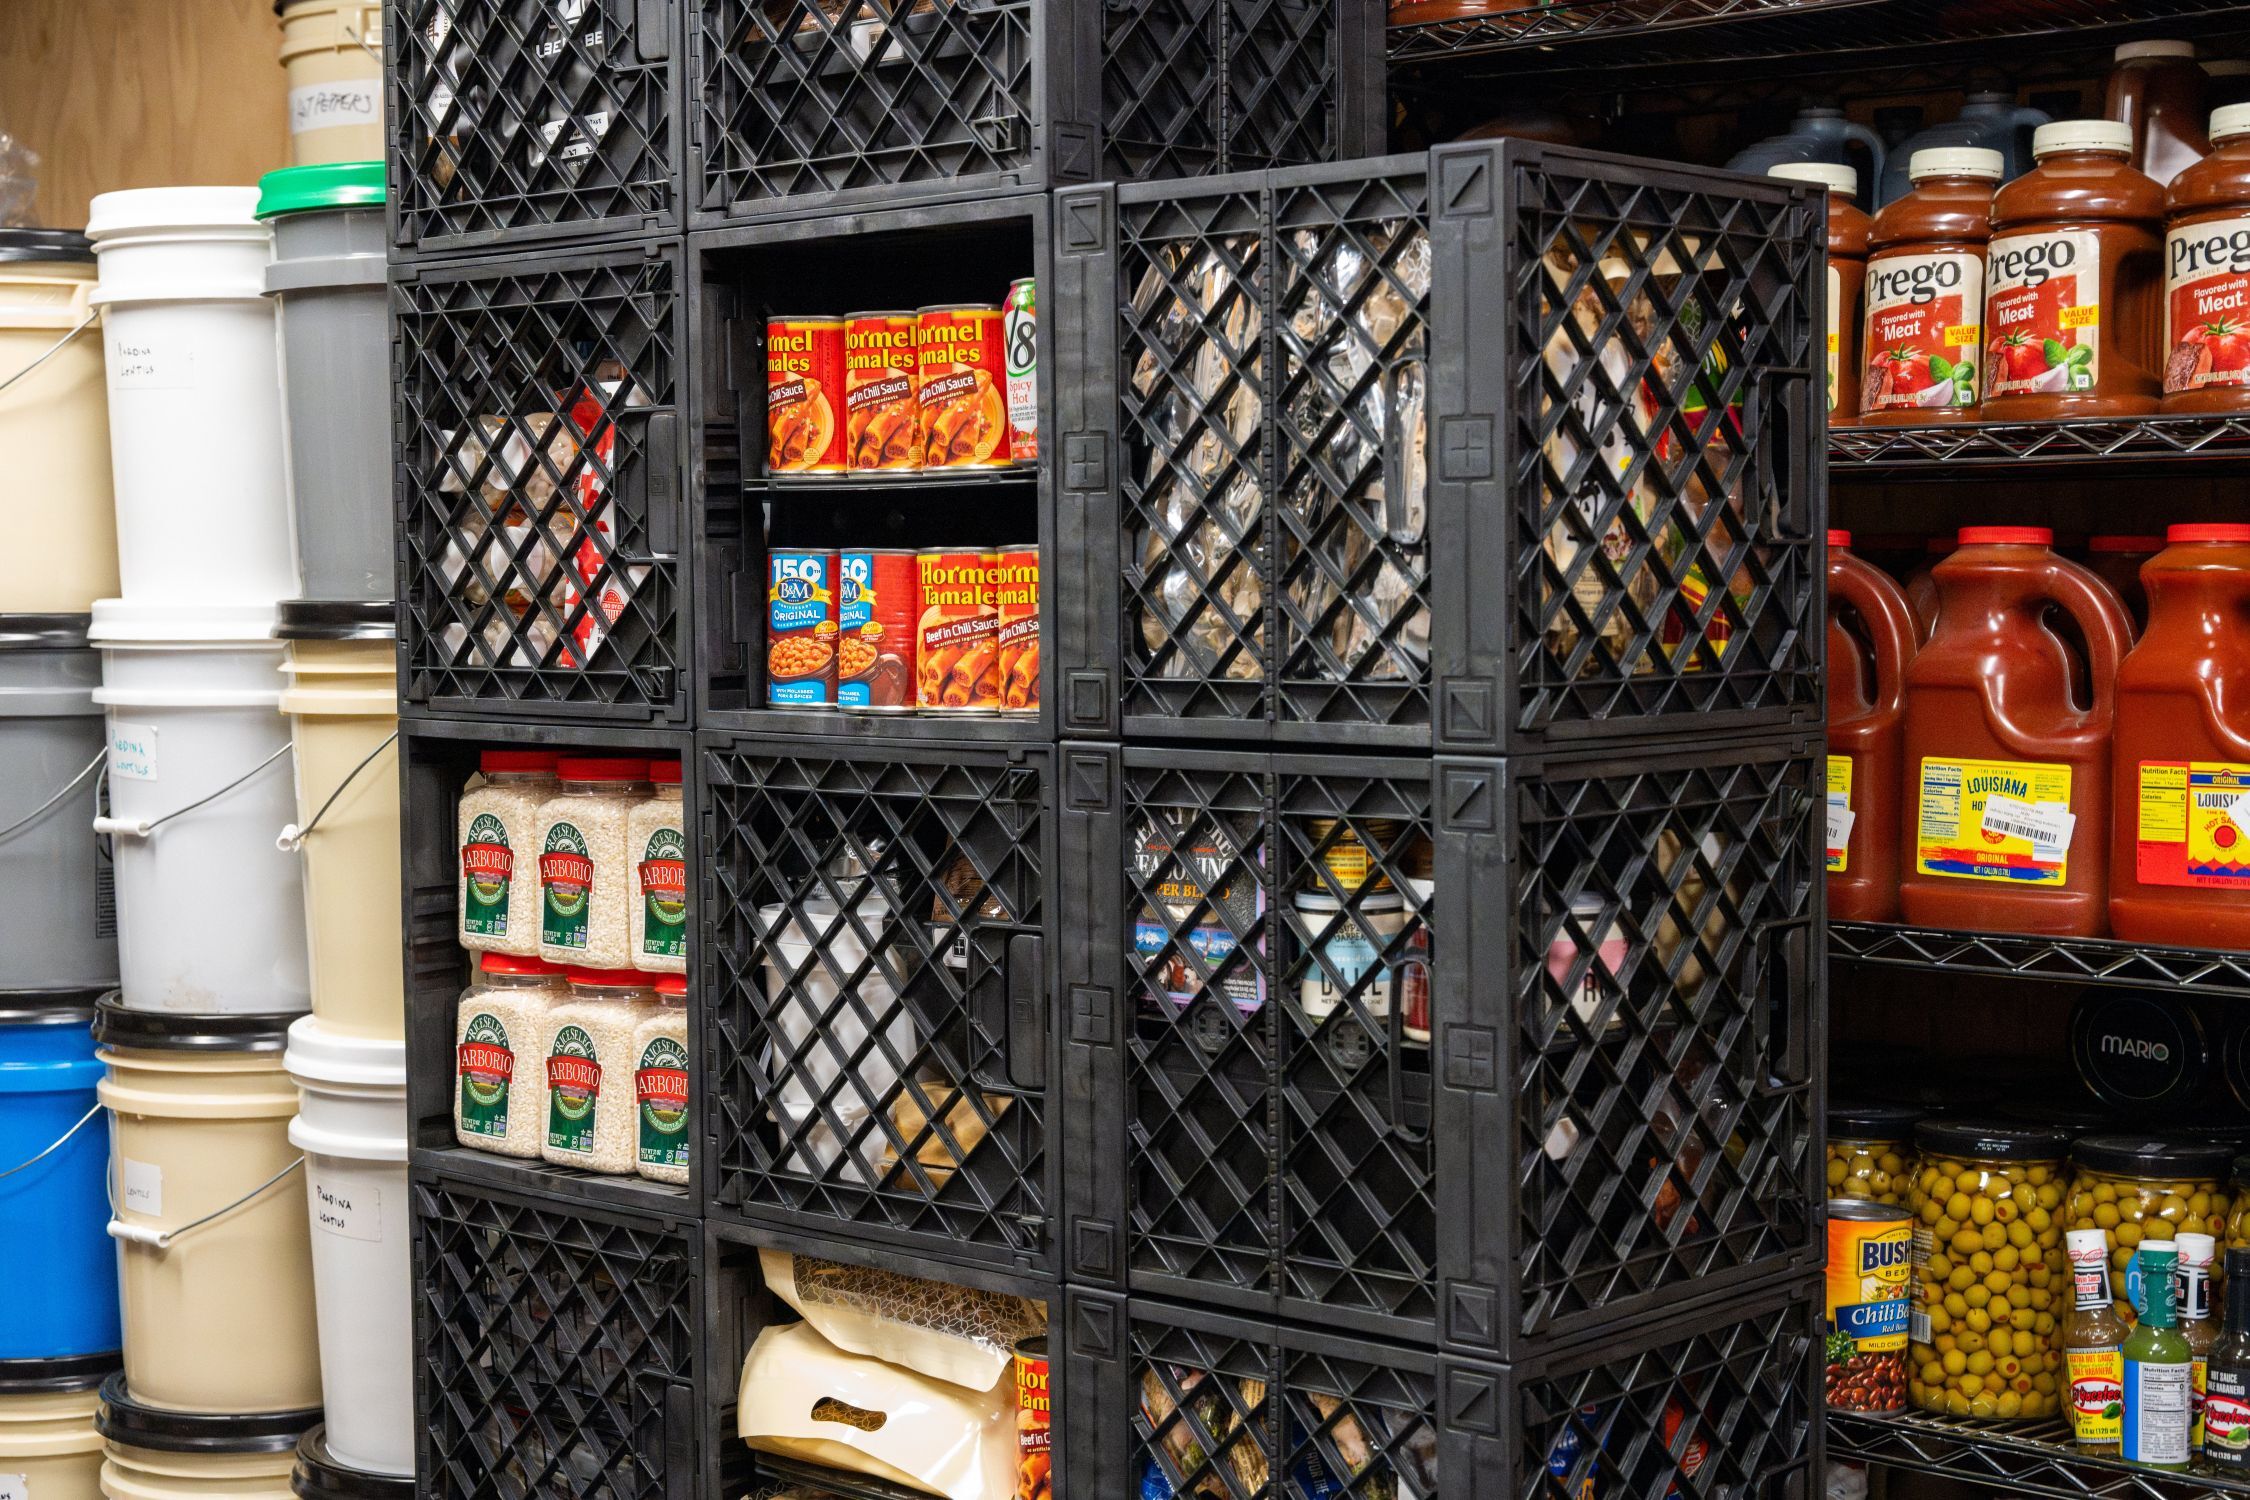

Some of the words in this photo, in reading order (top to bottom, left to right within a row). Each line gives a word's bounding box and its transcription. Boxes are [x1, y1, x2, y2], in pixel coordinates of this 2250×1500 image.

[1867, 260, 1962, 309] Prego
[2194, 282, 2227, 299] Flavored
[2228, 278, 2248, 292] with
[1996, 296, 2022, 311] Flavored
[2021, 291, 2039, 304] with
[2198, 290, 2244, 316] Meat
[1881, 312, 1908, 326] Flavored
[1908, 309, 1926, 322] with
[1999, 303, 2035, 327] Meat
[2064, 307, 2094, 318] VALUE
[2069, 316, 2091, 326] SIZE
[768, 329, 813, 353] rmel
[918, 318, 983, 345] ormel
[1884, 319, 1921, 342] Meat
[1949, 327, 1977, 336] VALUE
[1954, 334, 1975, 343] SIZE
[918, 343, 981, 366] amales
[781, 383, 804, 398] Sauce
[863, 384, 880, 401] Chili
[880, 380, 909, 396] Sauce
[931, 379, 946, 396] Chili
[946, 375, 974, 391] Sauce
[1009, 380, 1033, 394] Spicy
[1012, 392, 1029, 405] Hot
[772, 558, 822, 584] 150
[841, 558, 868, 584] 50
[998, 564, 1040, 585] orm
[779, 582, 810, 599] B&M
[773, 609, 821, 622] ORIGINAL
[925, 628, 943, 644] Beef
[943, 627, 952, 639] in
[951, 622, 972, 637] Chili
[971, 618, 999, 632] Sauce
[1011, 621, 1028, 638] Chili
[1027, 619, 1040, 631] Sa
[2141, 767, 2169, 775] Nutrition
[2169, 768, 2187, 776] Facts
[2212, 775, 2240, 785] ORIGINAL
[1966, 776, 2028, 799] LOUISIANA
[2180, 793, 2185, 801] 0
[2197, 792, 2240, 808] LOUISI
[2203, 817, 2220, 832] HOT
[547, 824, 586, 850] RICESELECT
[647, 830, 685, 856] RICESELE
[465, 849, 513, 872] ARBORIO
[1976, 852, 2009, 865] ORIGINAL
[542, 859, 592, 883] ARBORIO
[643, 865, 686, 887] ARBOR
[468, 1015, 507, 1041] RICESELECT
[555, 1027, 595, 1053] RICESELECT
[2101, 1034, 2170, 1061] MARIO
[461, 1048, 513, 1074] ARBORIO
[550, 1061, 600, 1087] ARBORIO
[638, 1074, 688, 1097] ARBORI
[1885, 1267, 1910, 1278] BEST
[1851, 1303, 1896, 1326] Chili
[1895, 1303, 1910, 1321] Be
[1881, 1323, 1895, 1334] Red
[1868, 1341, 1886, 1349] MILD
[1016, 1361, 1050, 1391] Hor
[2210, 1369, 2219, 1380] HOT
[2219, 1372, 2238, 1384] SAUCE
[1018, 1384, 1050, 1411] Tam
[2216, 1382, 2246, 1396] HABANERO
[1020, 1433, 1035, 1446] Beef
[1035, 1432, 1043, 1445] in
